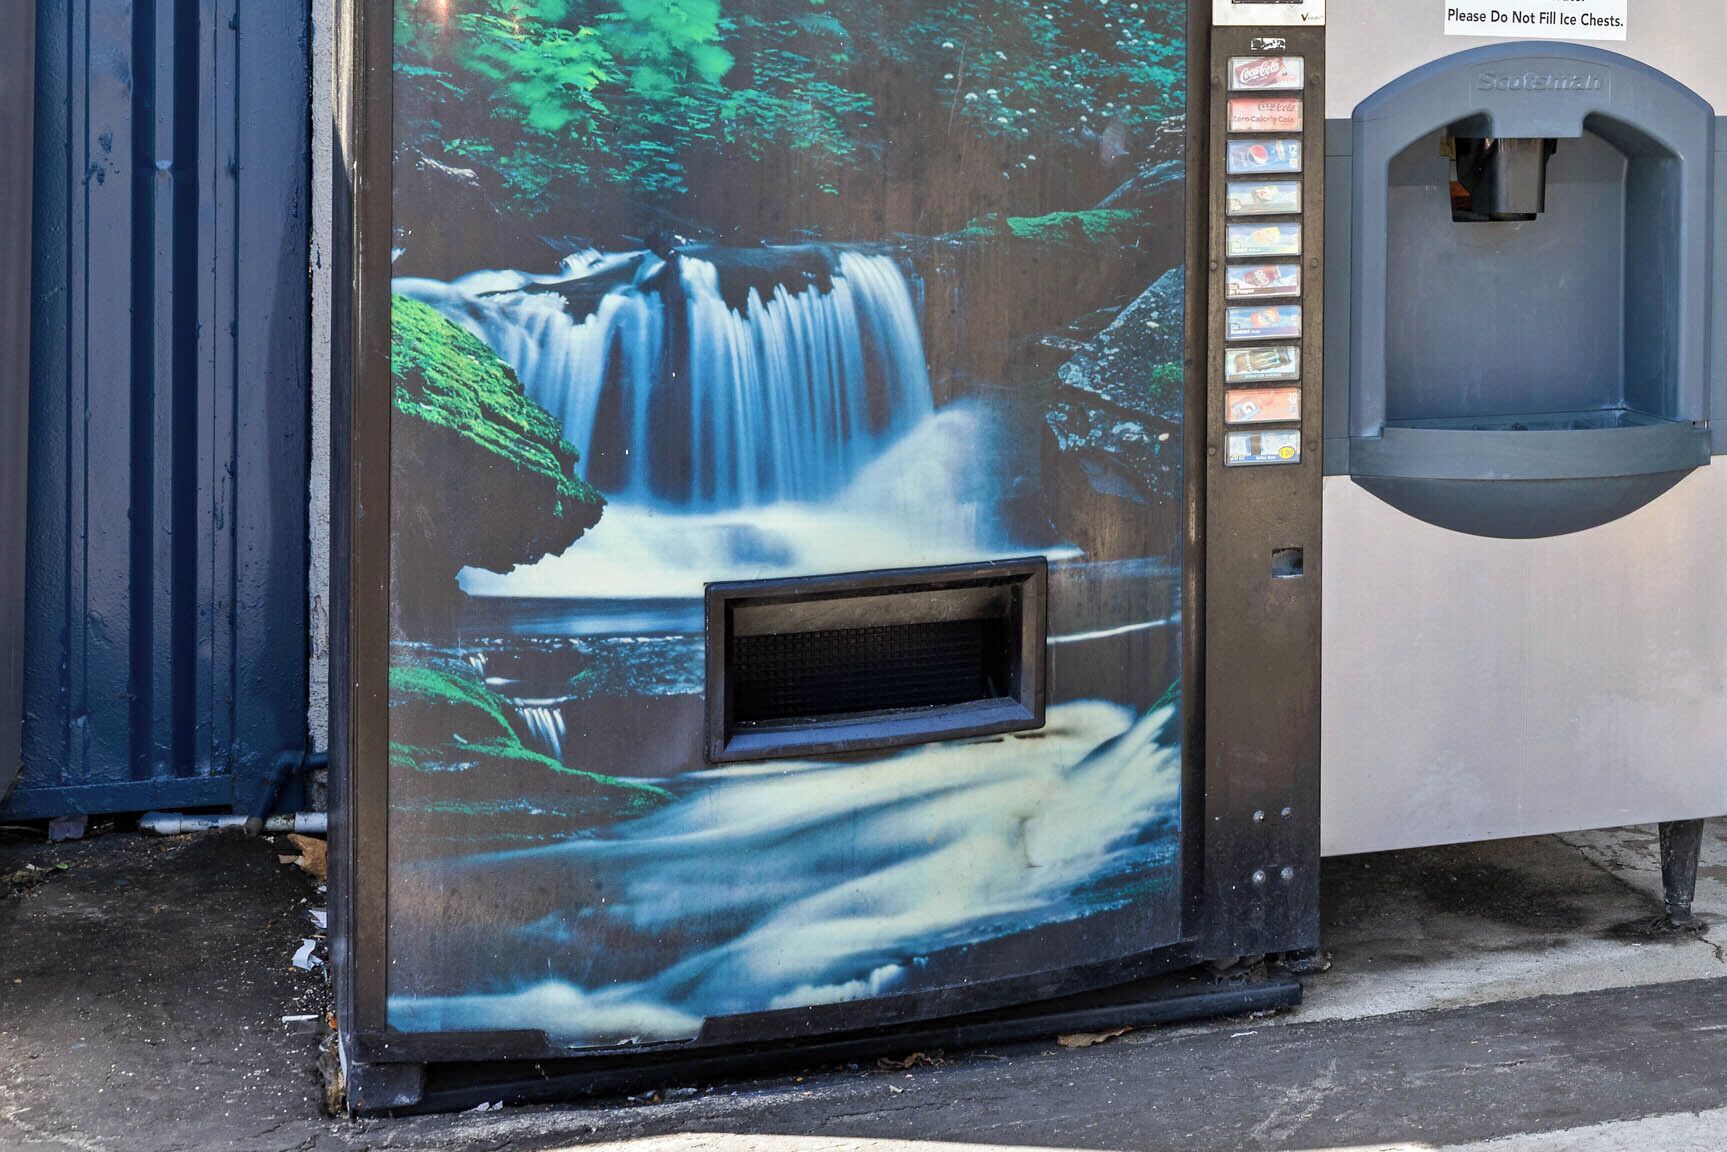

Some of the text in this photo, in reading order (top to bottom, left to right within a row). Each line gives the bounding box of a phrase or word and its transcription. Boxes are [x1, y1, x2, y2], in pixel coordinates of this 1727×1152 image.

[1447, 8, 1625, 28] Please Do Not Fill Ice Chests.
[1476, 70, 1601, 92] Scotsman
